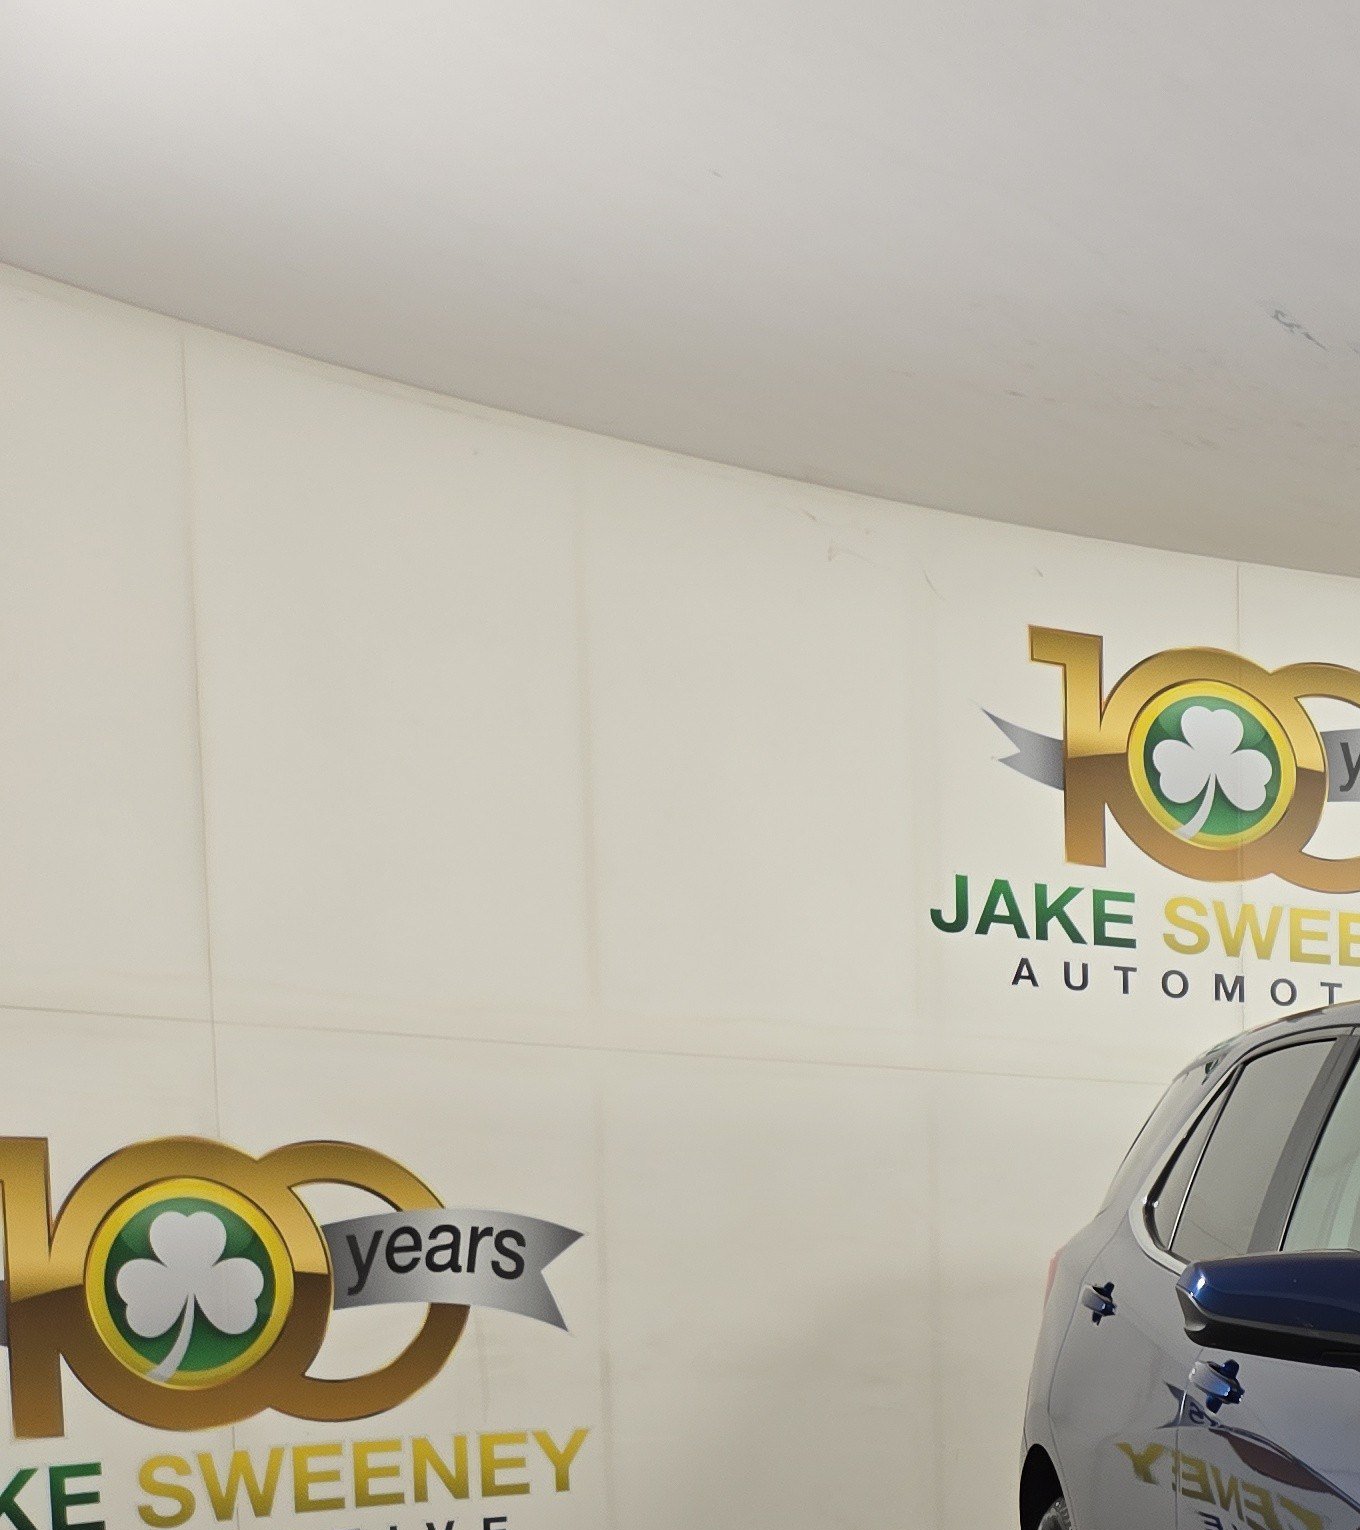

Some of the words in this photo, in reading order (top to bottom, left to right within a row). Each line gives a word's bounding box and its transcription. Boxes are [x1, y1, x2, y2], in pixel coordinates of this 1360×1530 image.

[929, 873, 1137, 949] JAKE
[345, 1223, 526, 1296] years
[137, 1428, 589, 1529] SWEENEY
